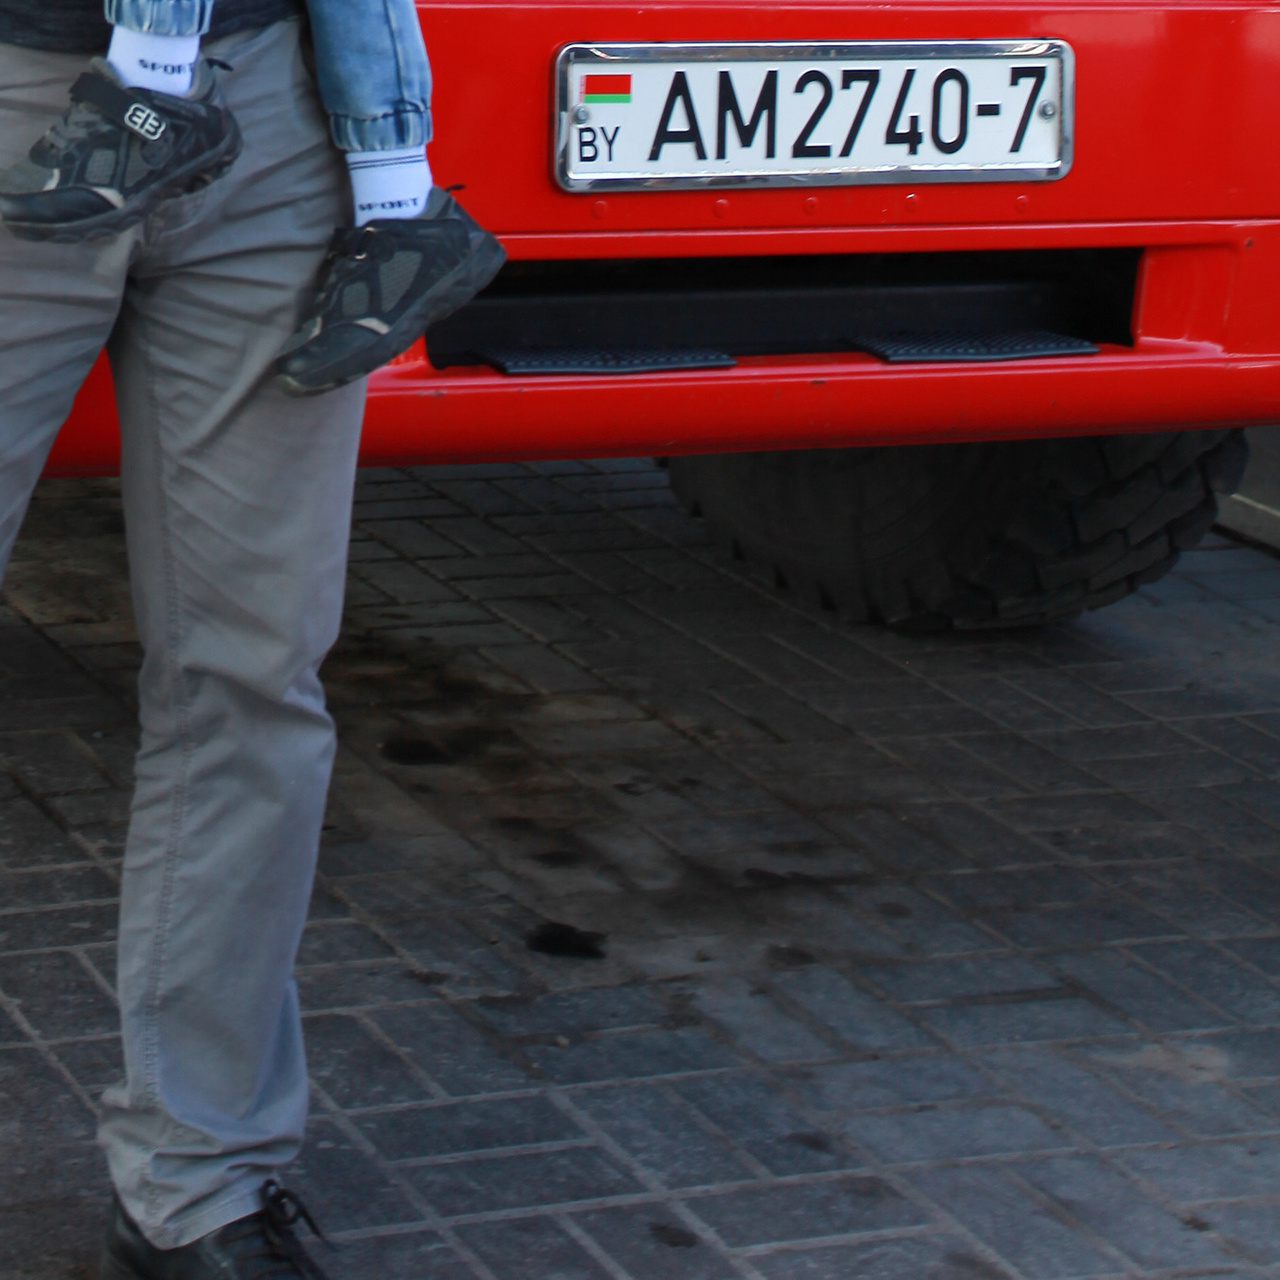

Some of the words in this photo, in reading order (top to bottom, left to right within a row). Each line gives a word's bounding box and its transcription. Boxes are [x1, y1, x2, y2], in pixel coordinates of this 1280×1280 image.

[647, 65, 1048, 161] AM2740-7
[578, 125, 621, 163] BY
[358, 197, 419, 212] SPORT
